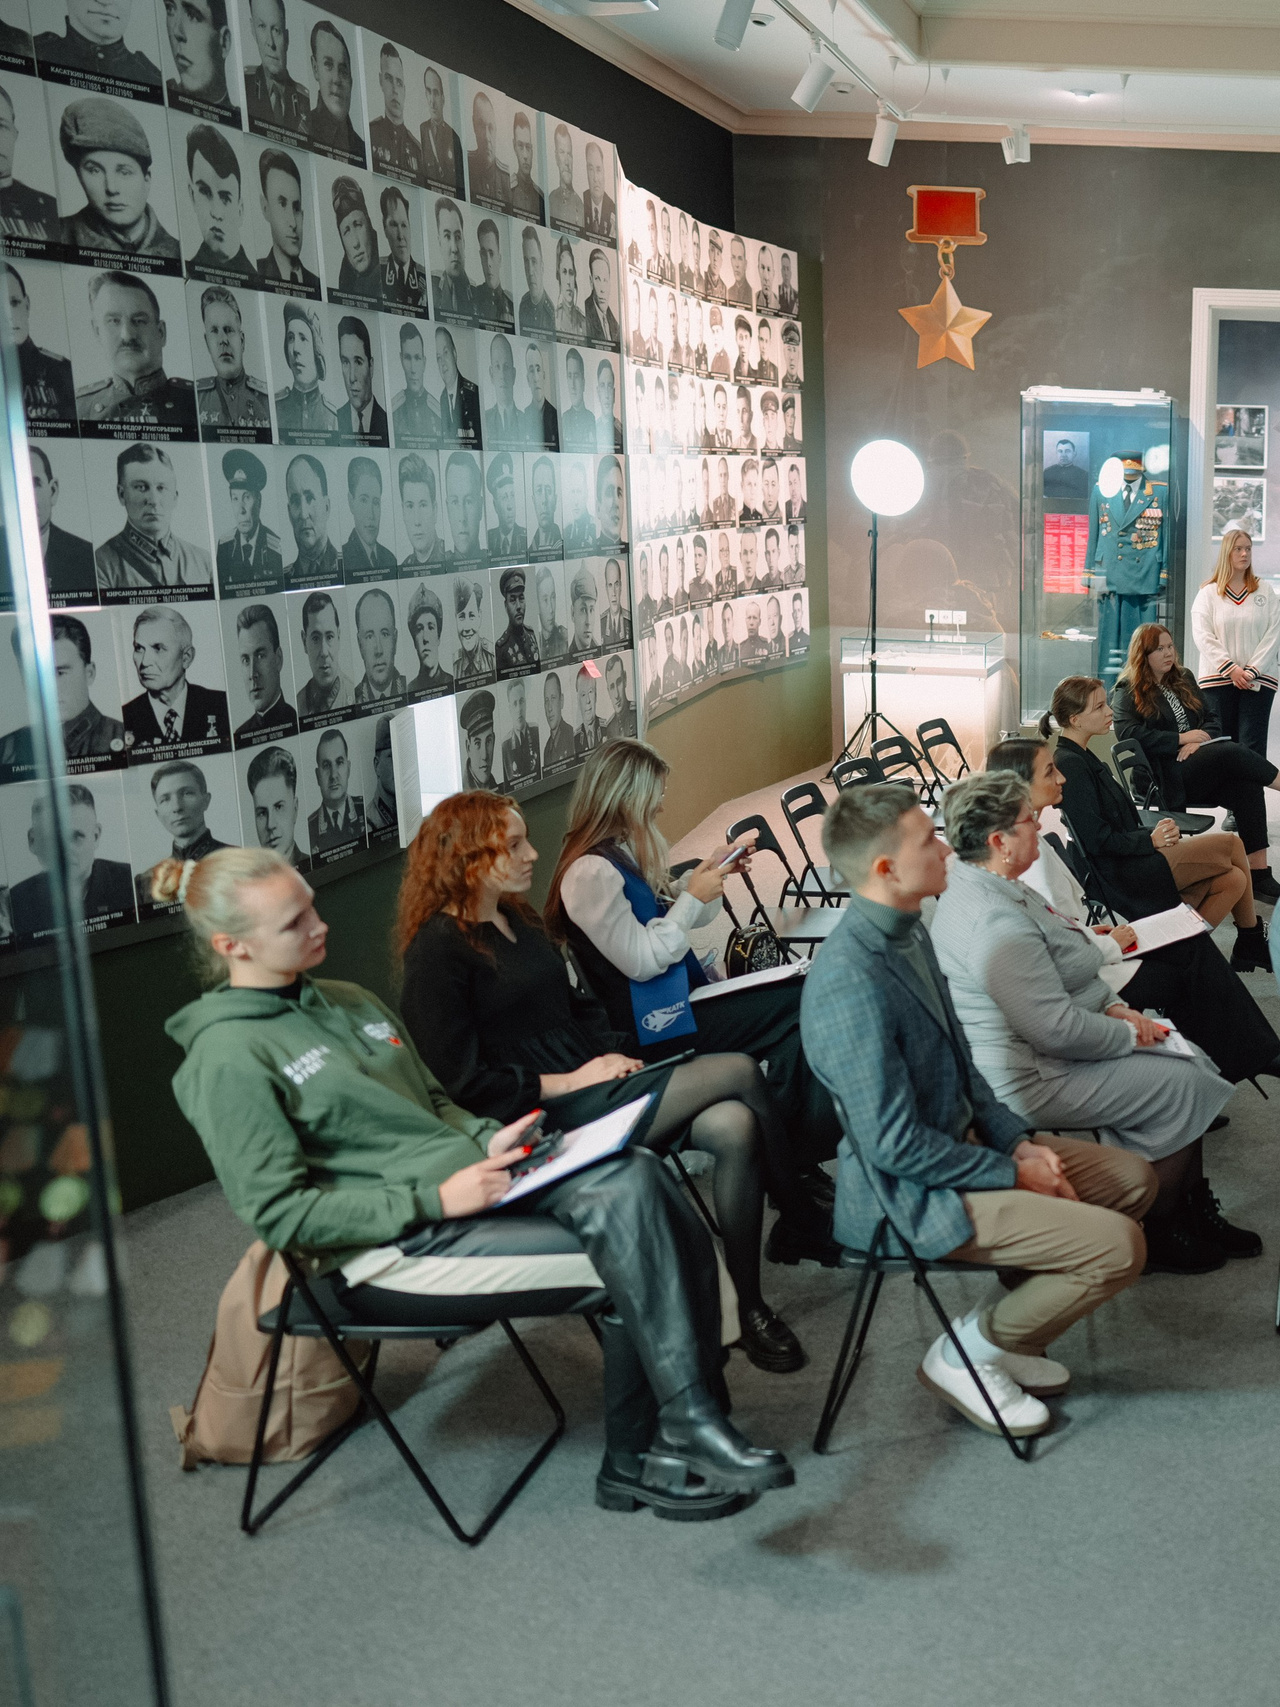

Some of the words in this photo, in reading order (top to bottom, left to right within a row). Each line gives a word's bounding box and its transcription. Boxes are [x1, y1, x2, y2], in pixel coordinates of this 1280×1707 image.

[50, 66, 85, 79] КАСАТКИН
[85, 71, 115, 85] НИКОЛАЙ
[115, 79, 150, 93] ЯКОВЛЕВИЧ
[100, 252, 129, 262] НИКОЛАЙ
[130, 256, 165, 266] АНДРЕЕВИЧ
[97, 423, 121, 431] КАТКОВ
[122, 424, 142, 432] ФЕДОР
[143, 425, 183, 433] ГРИГОРЬЕВИЧ
[106, 590, 138, 598] КИРСАНОВ
[138, 588, 172, 596] АЛЕКСАНДР
[172, 586, 209, 595] ВАСИЛЬЕВИЧ
[131, 747, 155, 756] КОВАЛЬ
[154, 743, 188, 753] АЛЕКСАНДР
[188, 738, 222, 748] МОИСЕЕВИЧ
[65, 754, 112, 766] МИХАЙЛОВИЧ
